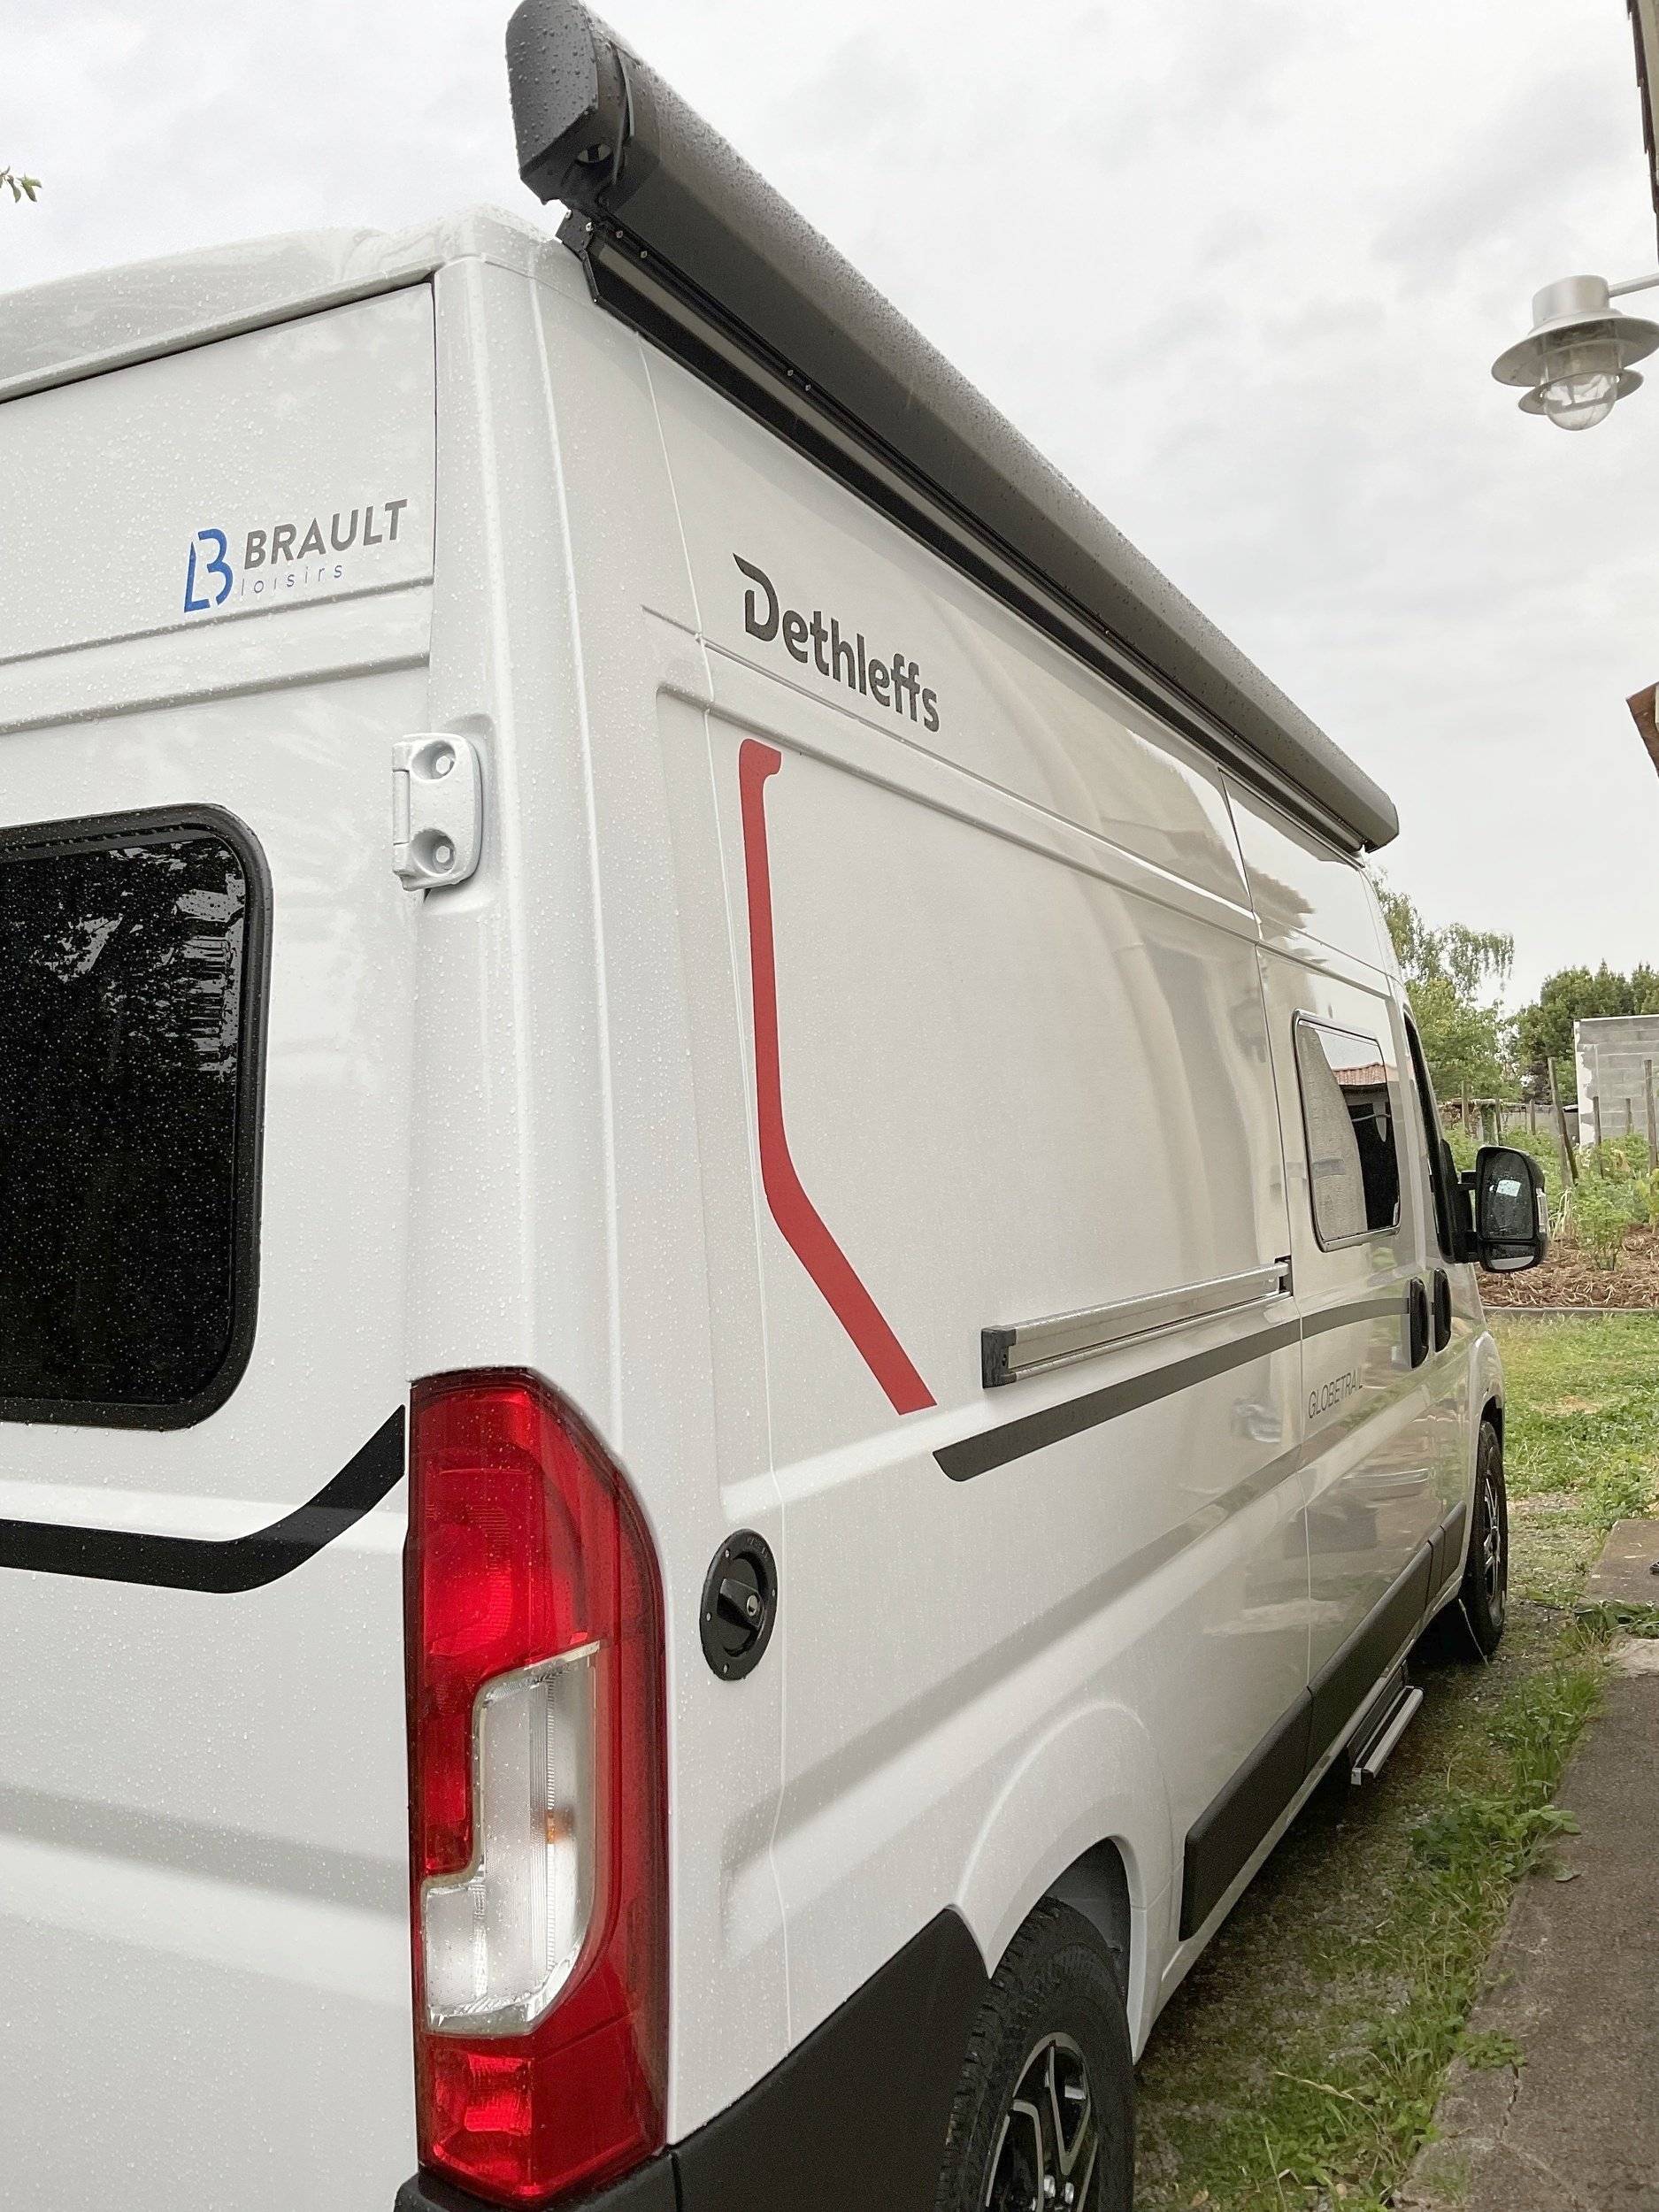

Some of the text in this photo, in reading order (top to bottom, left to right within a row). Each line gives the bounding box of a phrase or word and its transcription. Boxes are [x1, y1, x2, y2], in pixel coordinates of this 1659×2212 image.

[244, 499, 408, 570] BRAULT
[241, 565, 342, 596] loisirs
[733, 552, 940, 733] Dethleffs
